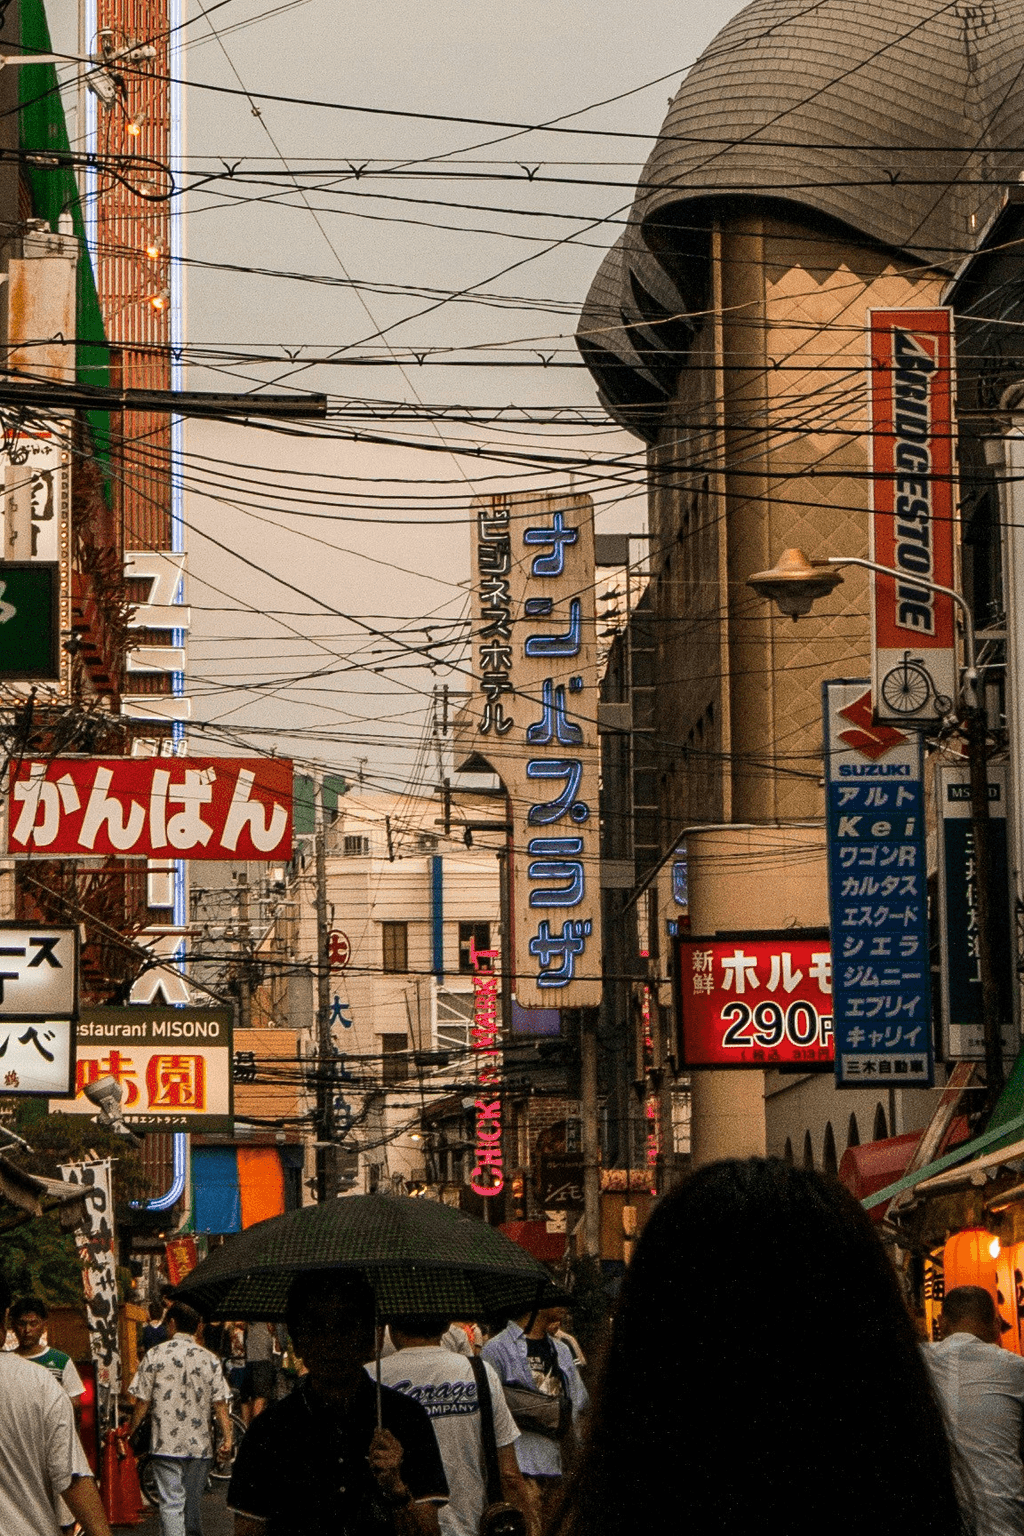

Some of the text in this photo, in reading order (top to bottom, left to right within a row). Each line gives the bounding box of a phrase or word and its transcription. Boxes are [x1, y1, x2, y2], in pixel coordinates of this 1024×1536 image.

[891, 324, 939, 636] BRIDGESTONE
[479, 510, 513, 736] ビジネスホテル
[524, 510, 593, 988] ナンバプラザ
[120, 552, 191, 1005] ユニース
[839, 764, 911, 777] SUZUKI
[12, 762, 288, 852] かんばん
[837, 785, 916, 807] アルト
[837, 816, 916, 838] Kei
[839, 845, 917, 868] ワゴンR
[840, 875, 919, 897] カルタス
[841, 905, 919, 928] エスクード
[842, 935, 920, 958] シエラ
[692, 950, 714, 995] 新鮮
[721, 950, 833, 994] ホルモ
[844, 966, 922, 987] ジムニー
[845, 996, 922, 1018] エブリイ
[77, 1021, 220, 1038] estaurant MISONO
[846, 1026, 923, 1048] キャリイ
[846, 1060, 924, 1074] 三木自動車
[77, 1050, 206, 1112] 味園
[470, 1066, 505, 1196] CHICKN
[426, 1402, 475, 1415] OMPANY
